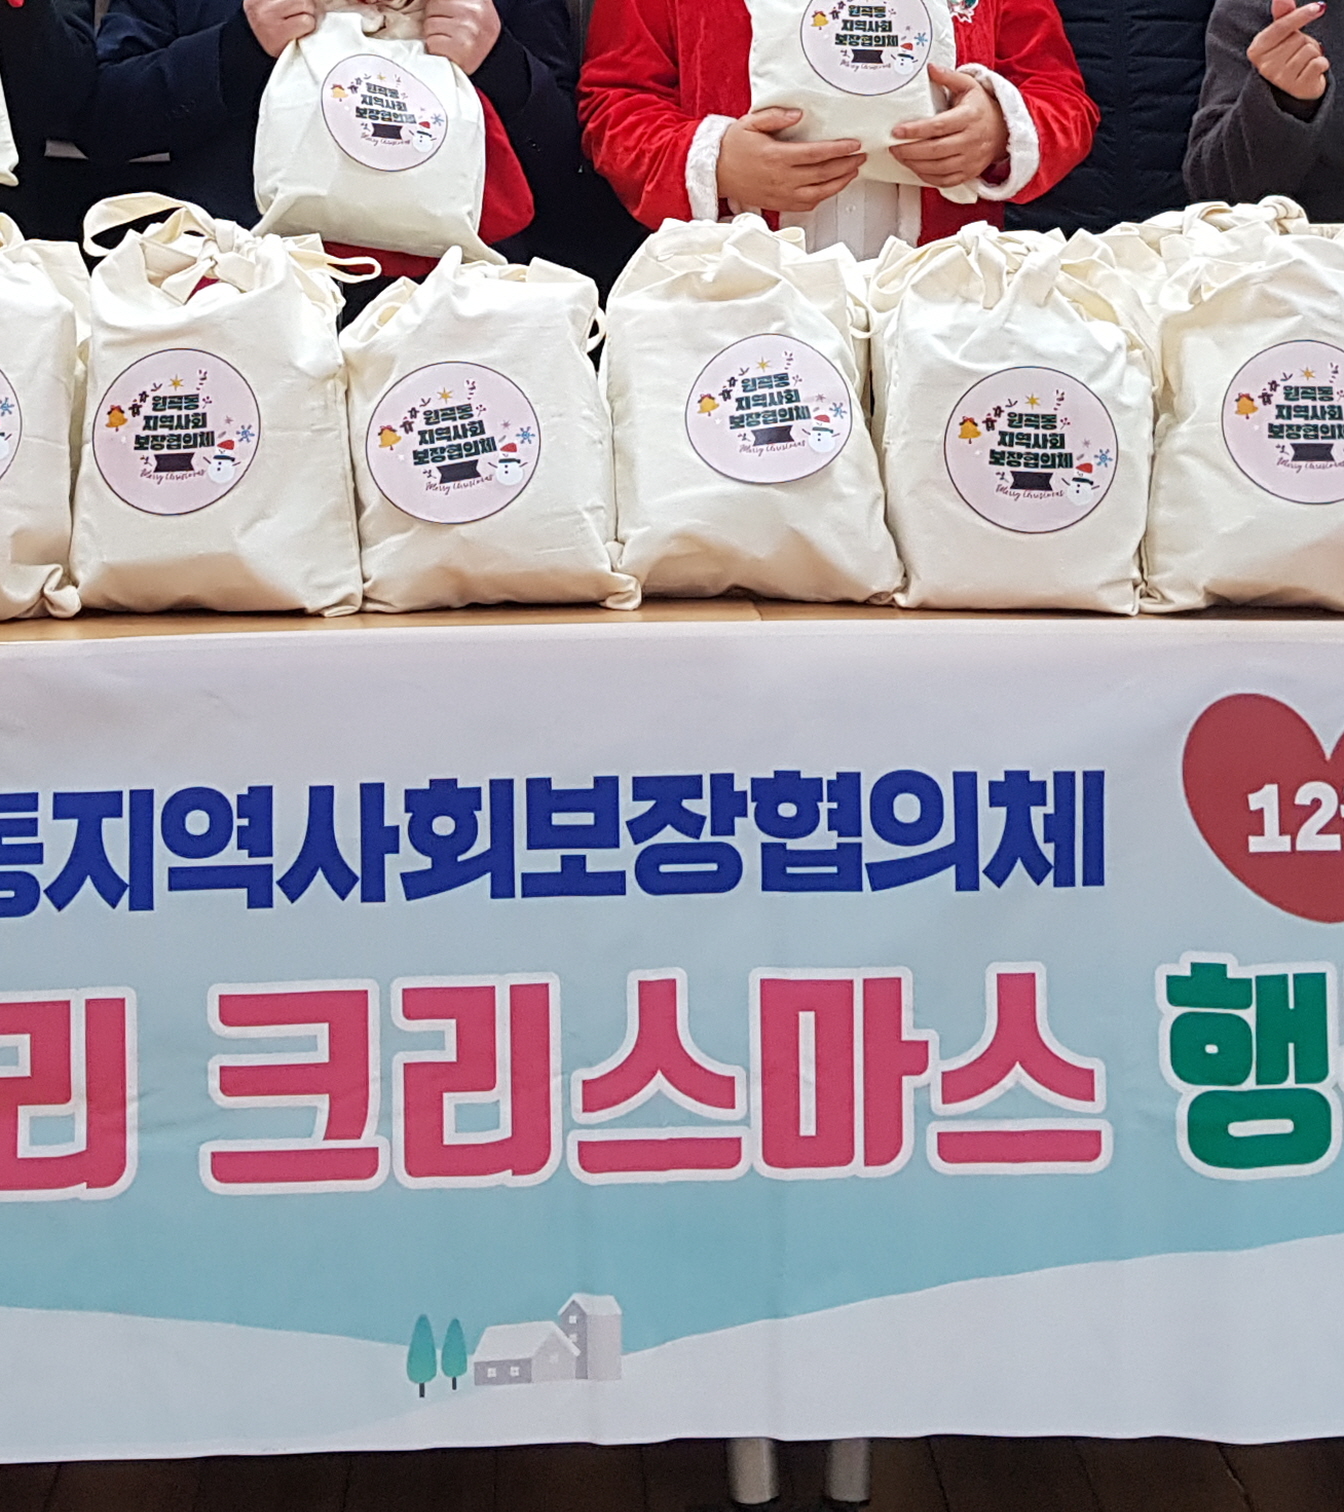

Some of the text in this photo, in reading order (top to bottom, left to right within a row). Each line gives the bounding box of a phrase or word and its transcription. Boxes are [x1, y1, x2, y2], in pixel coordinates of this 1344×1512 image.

[741, 373, 790, 393] 원곡동
[152, 393, 199, 411] 원곡동
[735, 389, 800, 411] 지역사회
[1283, 386, 1333, 401] 원곡동
[143, 413, 207, 430] 지역사회
[423, 404, 474, 425] 원곡동
[729, 405, 811, 430] 보장협의체
[1007, 411, 1057, 429] 원곡동
[1275, 404, 1344, 421] 지역사회
[134, 431, 215, 450] 보장협의체
[418, 419, 485, 446] 지역사회
[998, 430, 1065, 449] 지역사회
[412, 436, 497, 466] 보장협의체
[988, 449, 1073, 469] 보장협의체
[208, 970, 1104, 1194] 크리스마스
